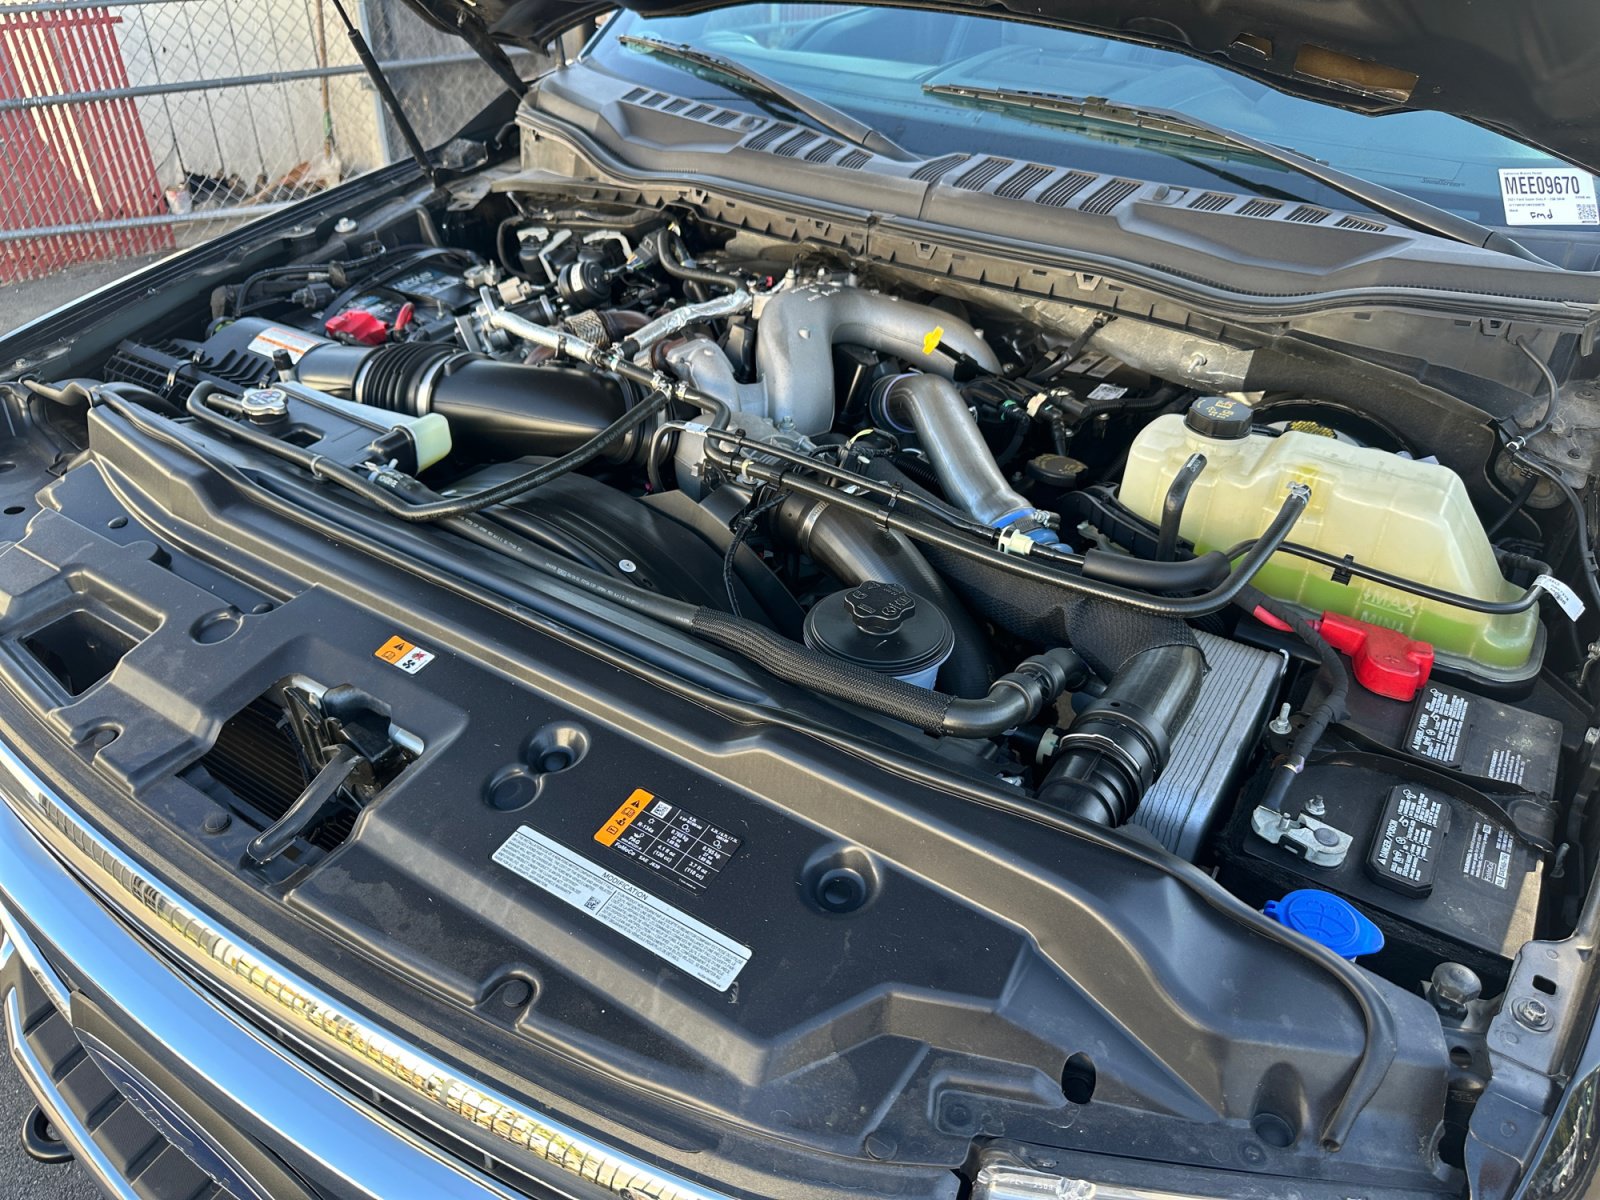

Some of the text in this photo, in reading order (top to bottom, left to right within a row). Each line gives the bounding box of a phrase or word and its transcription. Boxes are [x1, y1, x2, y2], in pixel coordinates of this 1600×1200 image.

[1504, 176, 1580, 194] MEE09670
[1371, 591, 1418, 614] MAX
[637, 822, 654, 833] R-134a
[629, 836, 640, 845] PAG
[1379, 819, 1398, 859] DANGER/POISON
[615, 842, 636, 856] FoMoCo
[639, 855, 649, 863] SAE
[602, 872, 648, 901] MODIFICATION
